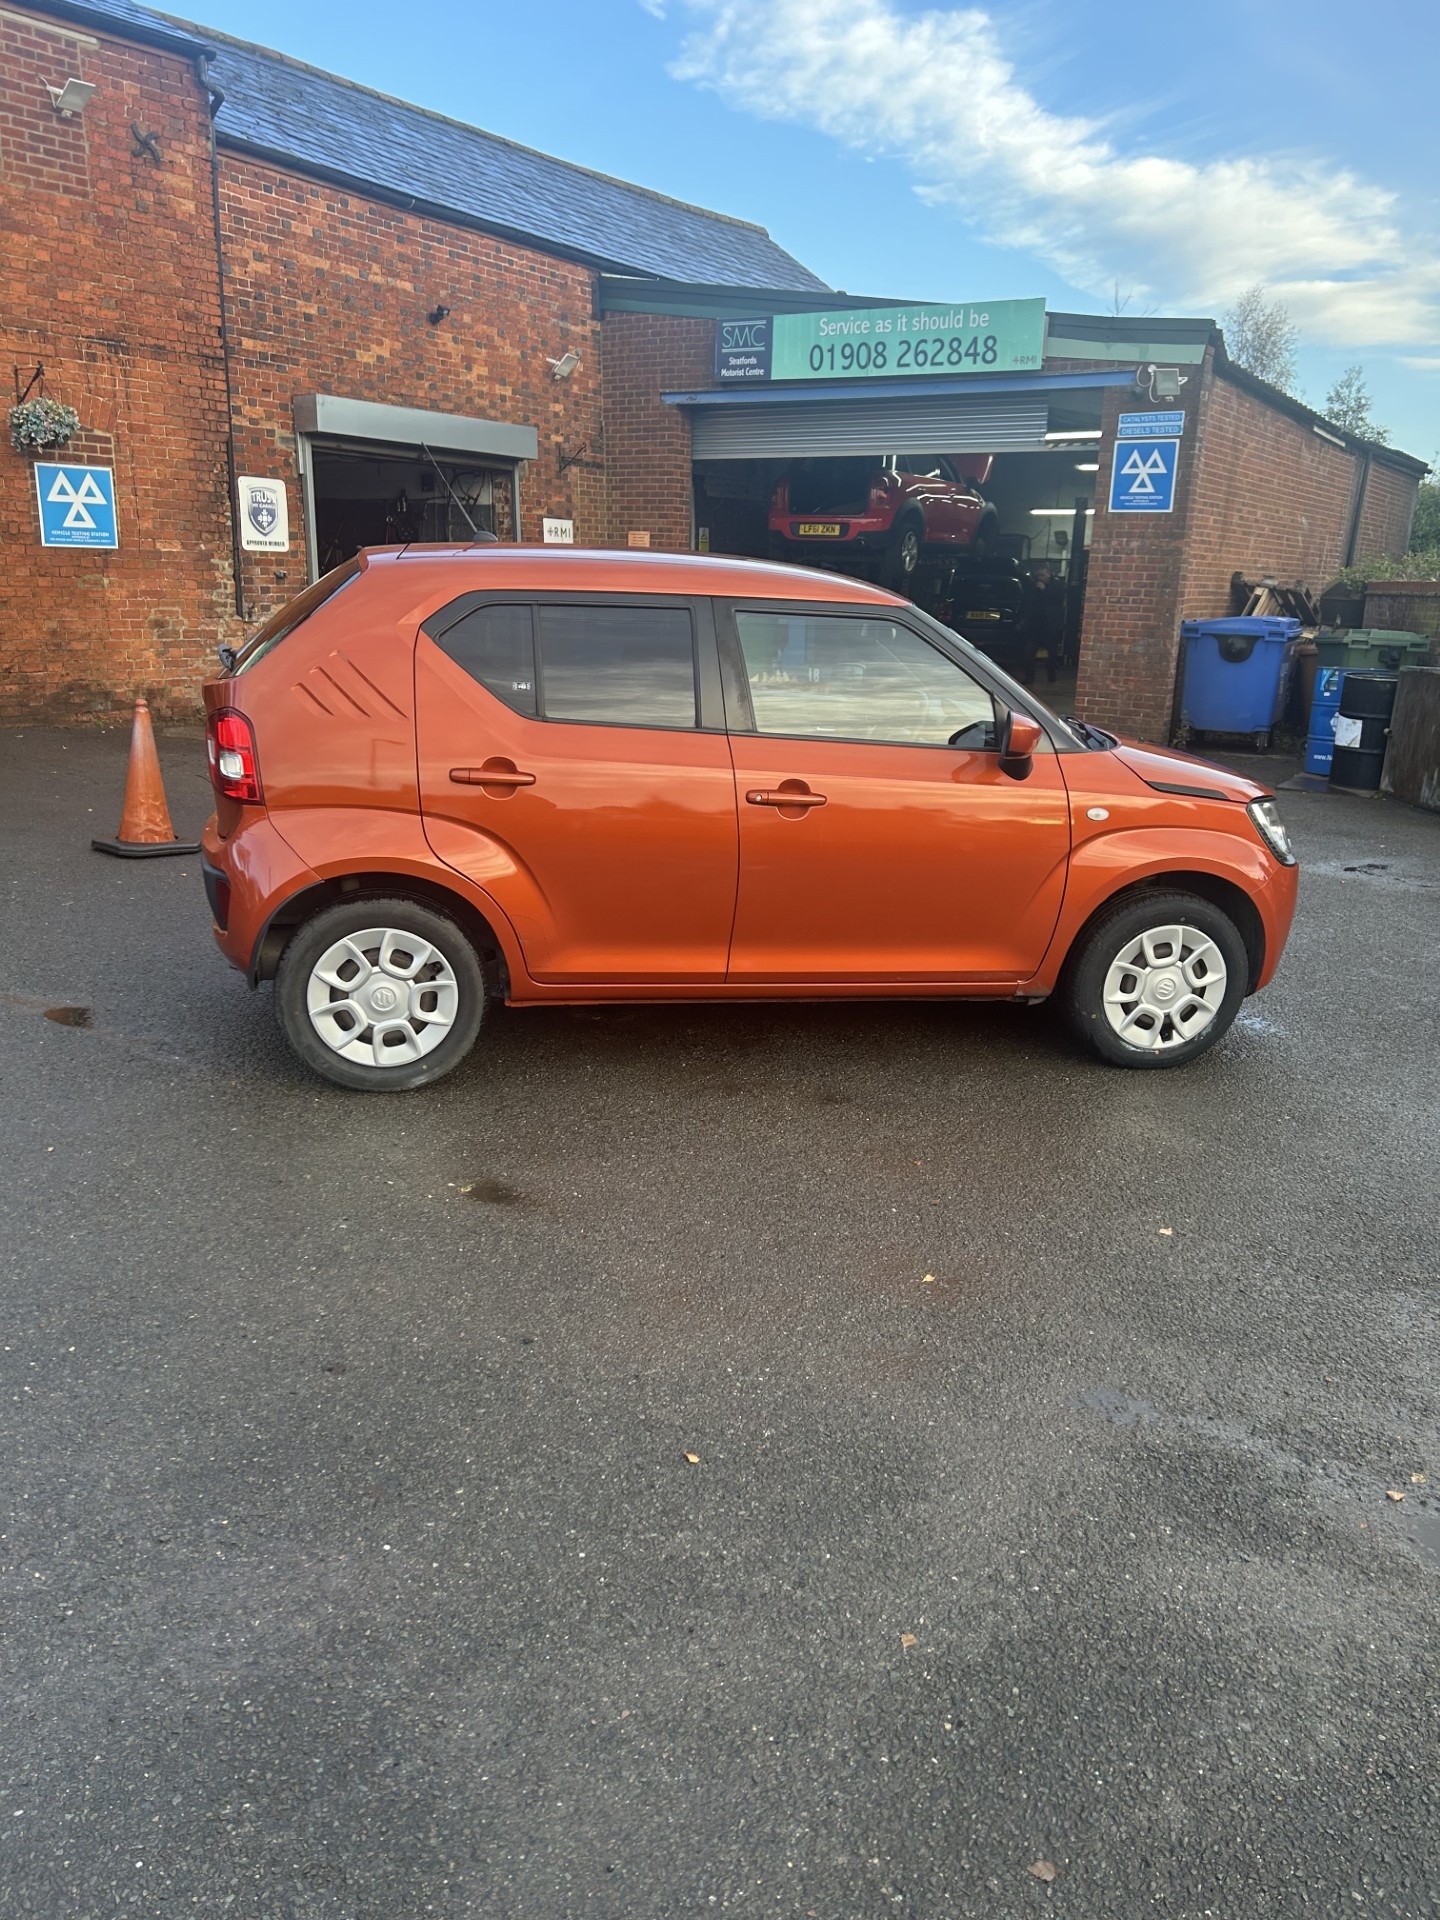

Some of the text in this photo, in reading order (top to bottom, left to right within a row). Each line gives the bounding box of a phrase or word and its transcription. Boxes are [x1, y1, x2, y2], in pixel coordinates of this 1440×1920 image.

[818, 309, 990, 337] Service as it should be
[722, 323, 766, 348] SMC
[808, 334, 998, 372] 01908 262848
[728, 355, 757, 366] Stratfords
[721, 366, 765, 377] Motorist Centre
[1157, 414, 1180, 422] TESTED
[1151, 426, 1179, 434] TESTED
[554, 527, 571, 539] RMI
[820, 525, 836, 534] ZKN
